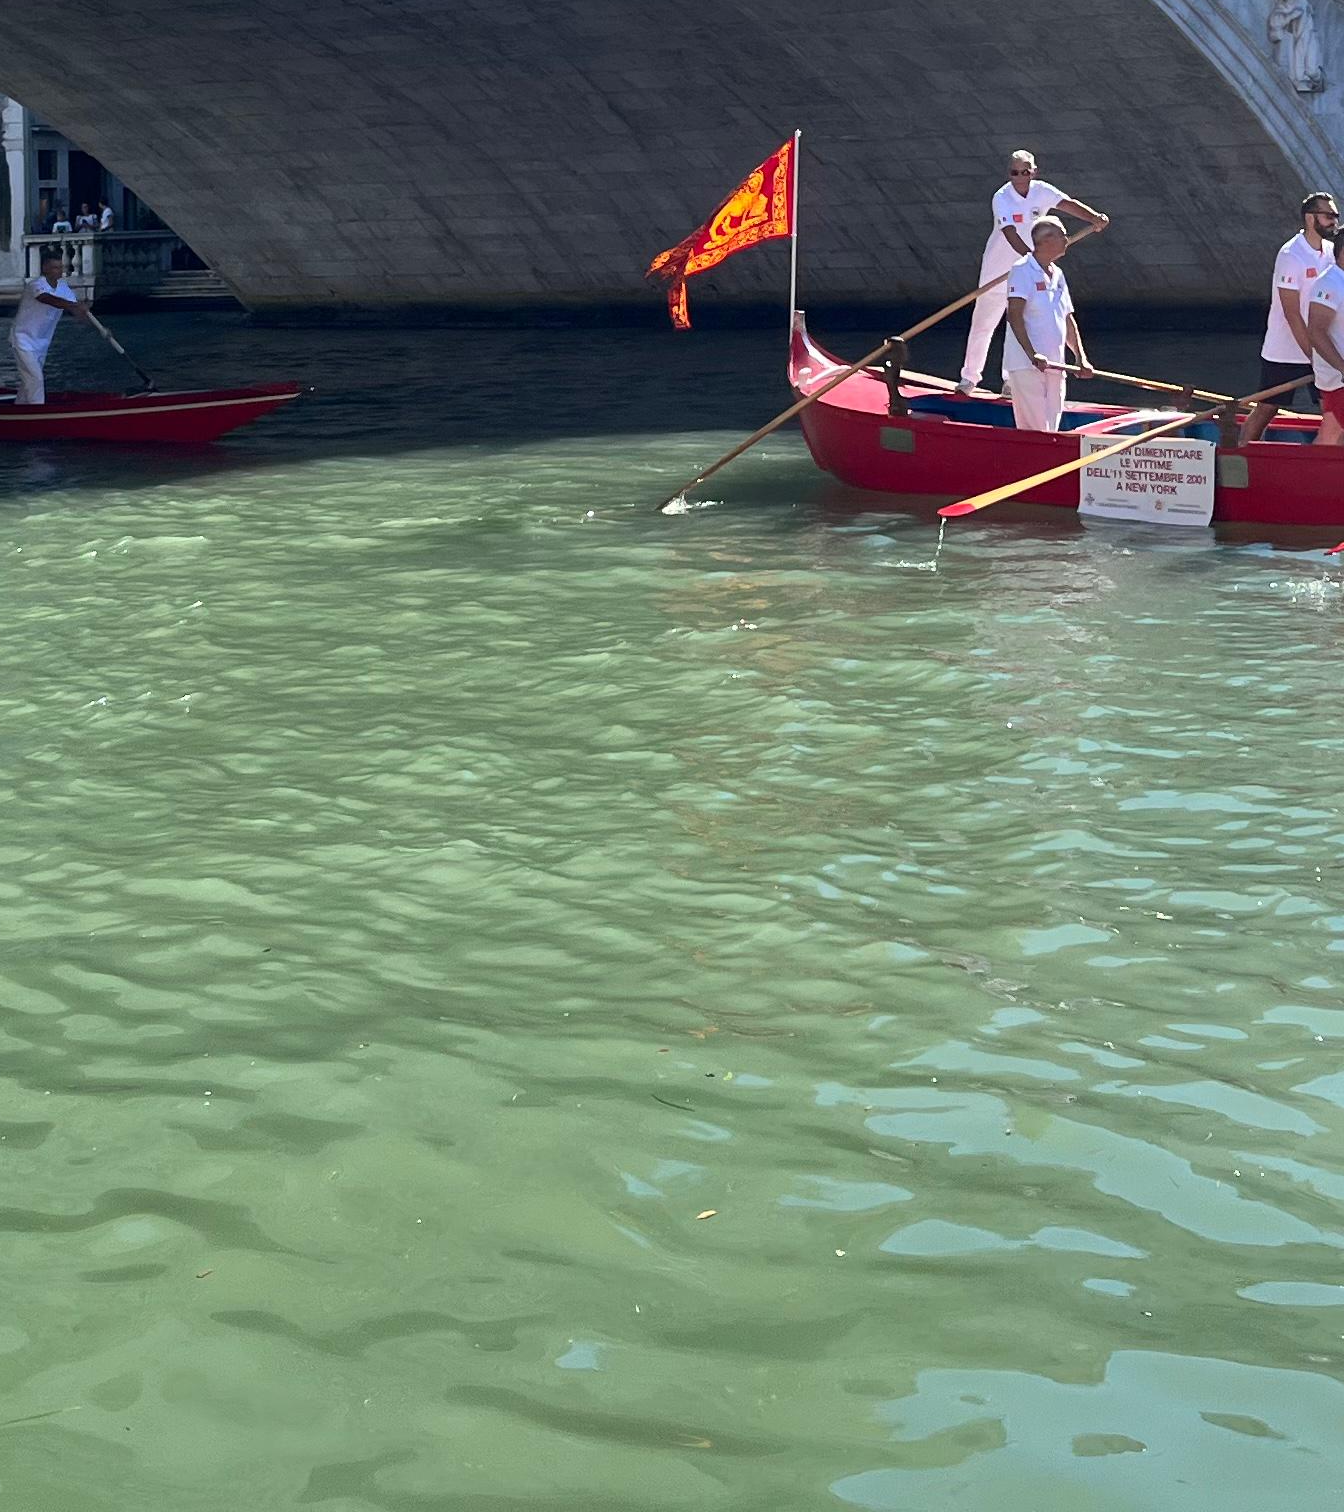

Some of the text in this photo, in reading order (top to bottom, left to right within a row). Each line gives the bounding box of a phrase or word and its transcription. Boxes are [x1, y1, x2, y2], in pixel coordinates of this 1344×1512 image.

[1134, 447, 1203, 461] DIMENTICARE
[1120, 458, 1173, 471] LE VITTIME
[1086, 467, 1207, 485] DELL'11 SETTEMBRE 2001
[1115, 481, 1178, 495] A NEW YORK
